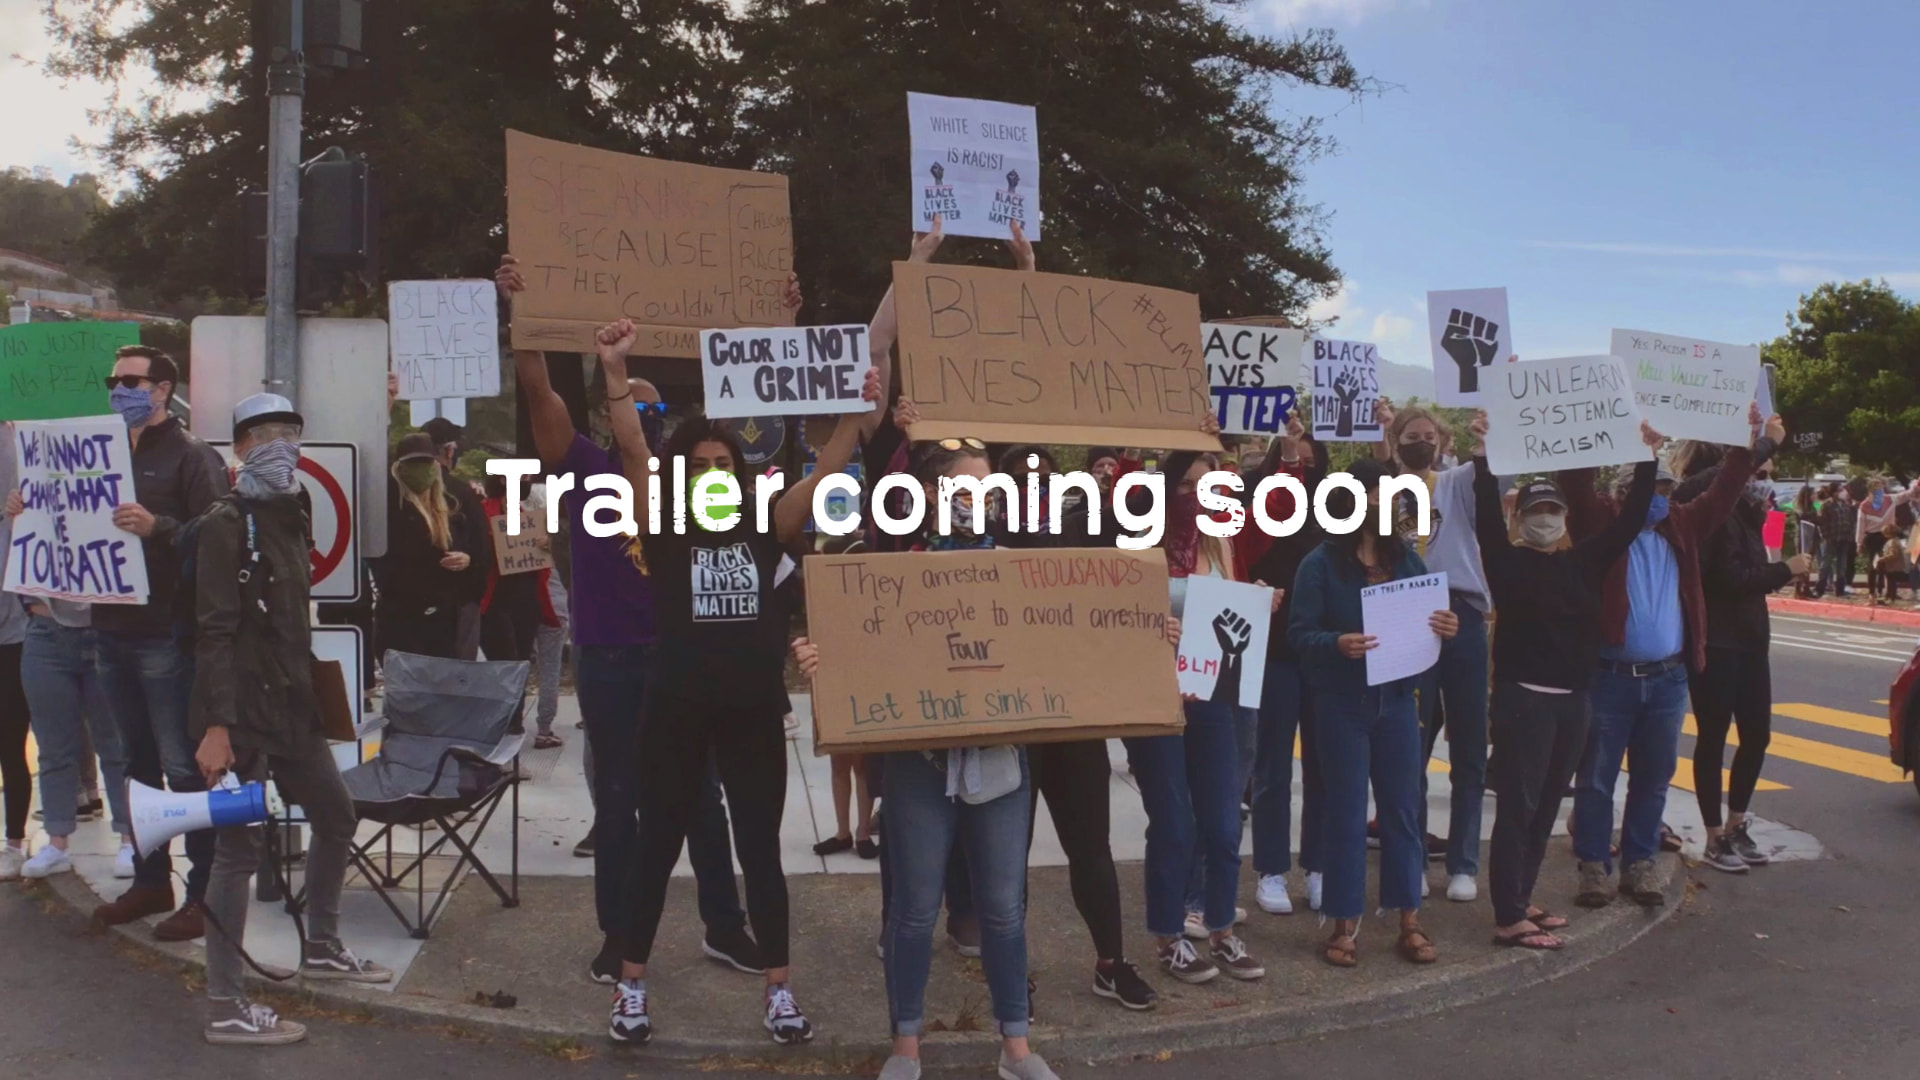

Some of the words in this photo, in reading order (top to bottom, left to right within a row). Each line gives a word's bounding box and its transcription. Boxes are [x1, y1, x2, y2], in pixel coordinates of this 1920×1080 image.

[930, 116, 969, 135] WHITE
[981, 122, 1028, 142] SILENCE
[947, 147, 959, 164] IS
[962, 149, 1004, 170] RACIST
[924, 188, 955, 199] BLACK
[924, 199, 957, 211] LIVES
[994, 191, 1025, 208] BLACK
[988, 211, 1026, 231] MATR
[991, 201, 1025, 219] LIVES
[559, 222, 718, 267] BECAUSE
[740, 241, 789, 271] RACE
[534, 264, 620, 296] THEY
[740, 275, 783, 297] RIOT
[395, 285, 487, 320] BLACK
[925, 275, 1127, 348] BLACK
[396, 321, 494, 356] LIVES
[653, 330, 701, 351] SUM
[783, 339, 799, 359] IS
[806, 327, 865, 363] NOT
[1132, 293, 1194, 368] #BLM
[1204, 328, 1278, 363] ACK
[1314, 340, 1376, 365] BLACK
[1693, 344, 1706, 358] IS
[1712, 348, 1722, 360] A
[48, 363, 100, 394] PEA
[720, 375, 734, 398] A
[754, 365, 860, 403] CRIME
[907, 353, 1042, 406] LIVES
[1070, 359, 1209, 414] MATTER
[1207, 363, 1265, 387] IVES
[1508, 363, 1625, 400] UNLEARN
[1210, 385, 1297, 434] TTER
[1518, 398, 1629, 426] SYSTEMIC
[1635, 392, 1658, 406] ENCE
[42, 430, 113, 475] CANNOT
[1524, 431, 1614, 459] RACISM
[65, 473, 122, 514] WHAT
[498, 516, 536, 532] Bck
[13, 531, 134, 594] TOLERATE
[697, 546, 748, 572] BLACK
[700, 566, 753, 592] LIVES
[826, 561, 904, 606] They
[922, 564, 999, 589] arrested
[1009, 558, 1143, 589] THOUSANDS
[1363, 588, 1377, 598] SAY
[1381, 583, 1404, 595] THEIR
[694, 594, 758, 617] MATTER
[863, 605, 885, 636] of
[905, 599, 976, 636] people
[992, 600, 1009, 627] to
[1023, 603, 1073, 627] avoid
[1090, 603, 1166, 640] arresting
[946, 632, 996, 662] Four
[1177, 654, 1219, 677] BLM
[850, 692, 903, 726] Let
[917, 690, 969, 721] that
[985, 687, 1032, 718] sink
